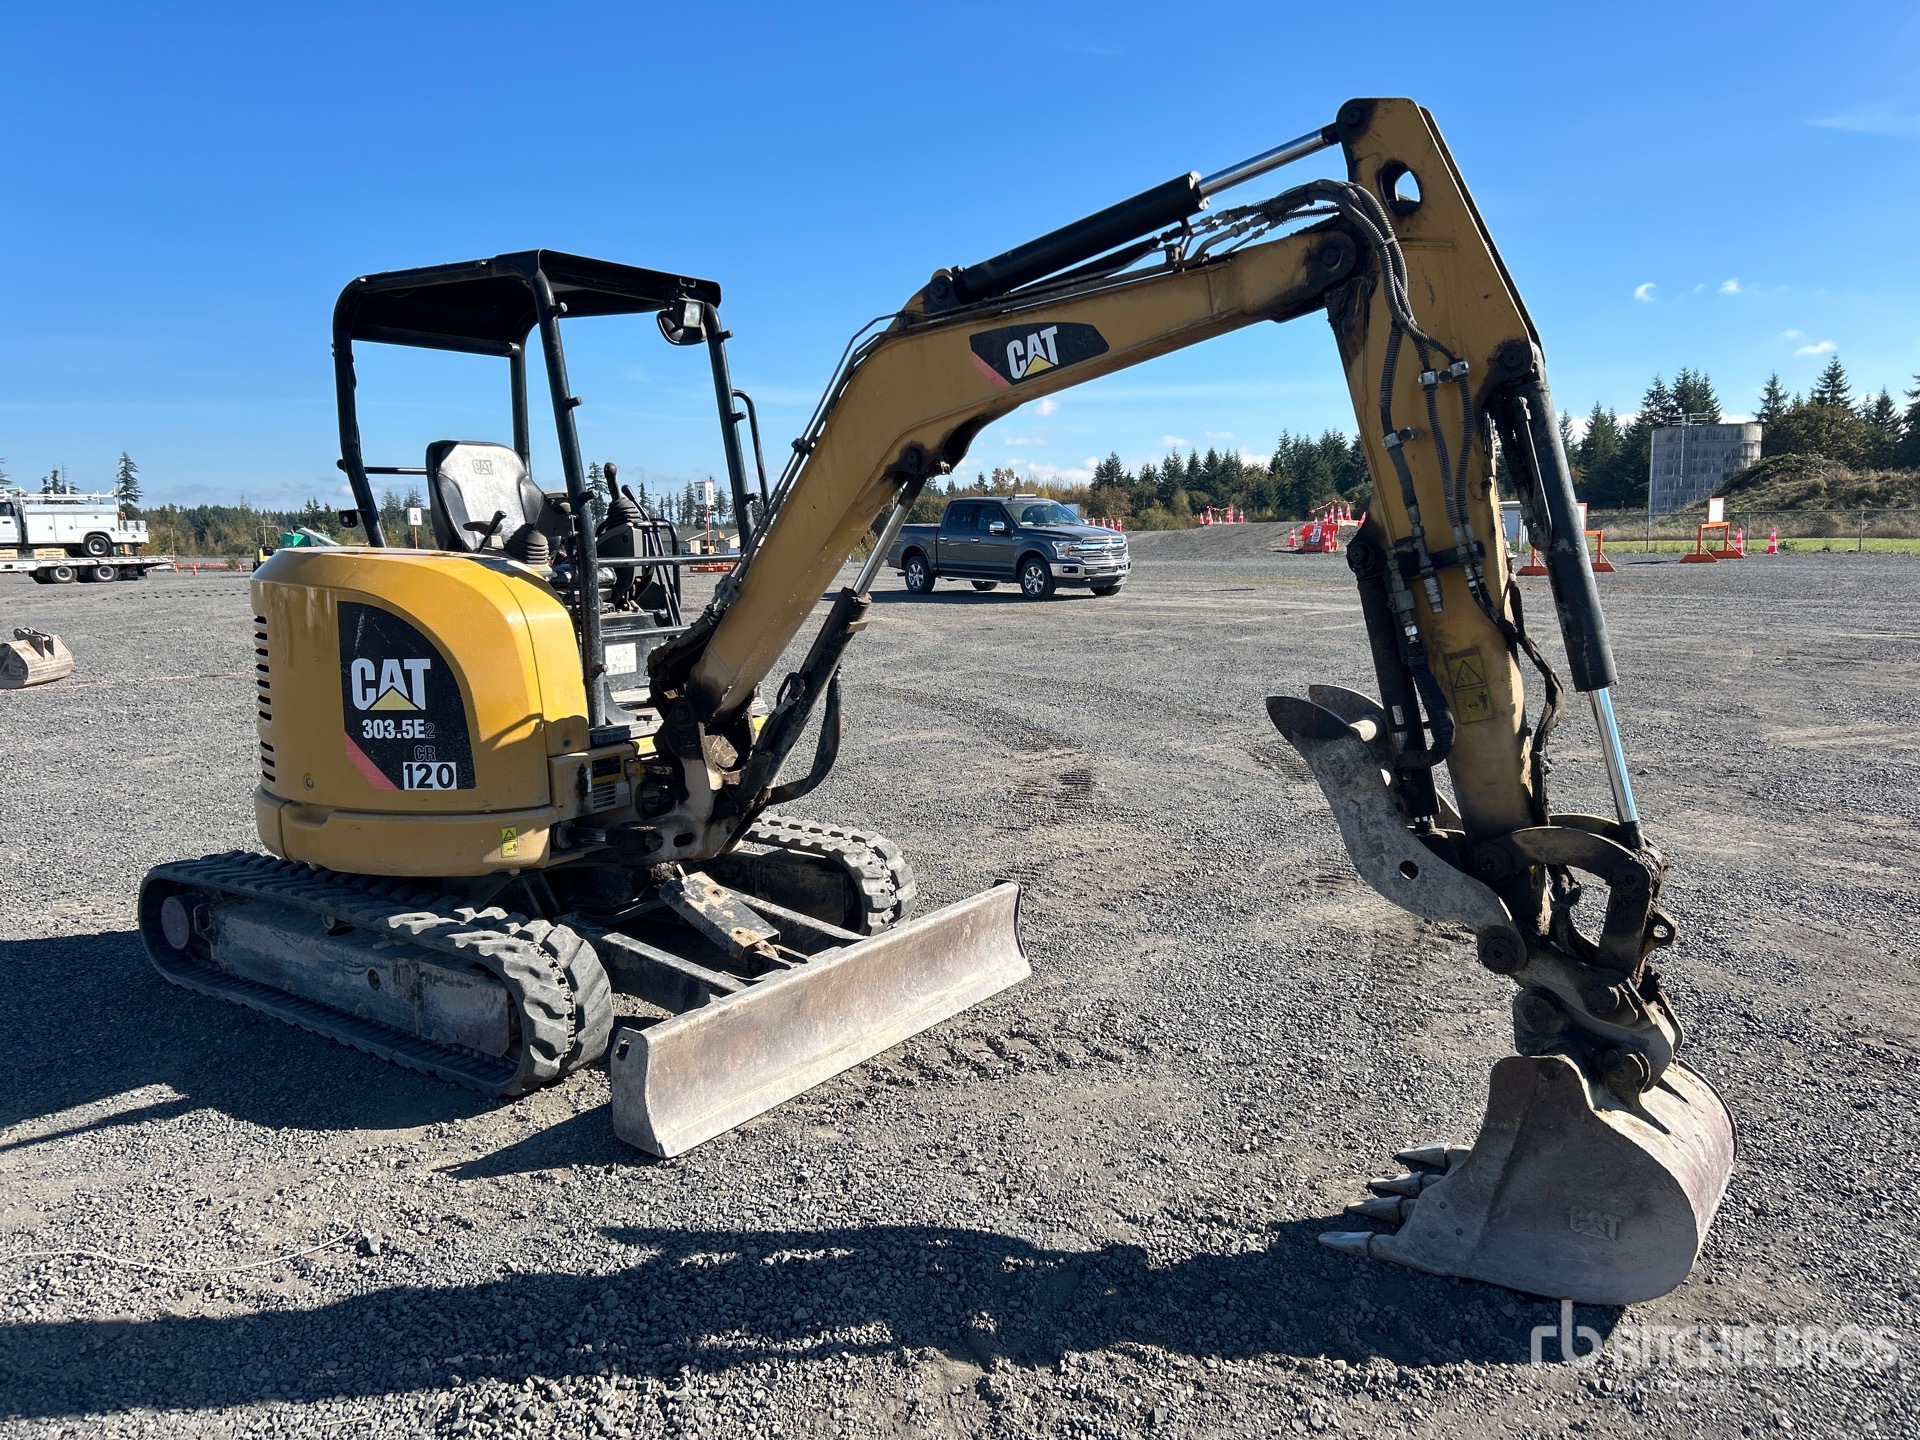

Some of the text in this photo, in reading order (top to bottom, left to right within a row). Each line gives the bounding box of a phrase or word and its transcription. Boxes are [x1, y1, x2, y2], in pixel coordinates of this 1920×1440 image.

[1006, 325, 1058, 380] CAT
[472, 459, 493, 475] CAT
[351, 658, 431, 710] CAT
[362, 719, 436, 739] 303.5E2
[414, 745, 436, 761] CR
[404, 763, 455, 789] 120
[1568, 1205, 1622, 1241] CAT
